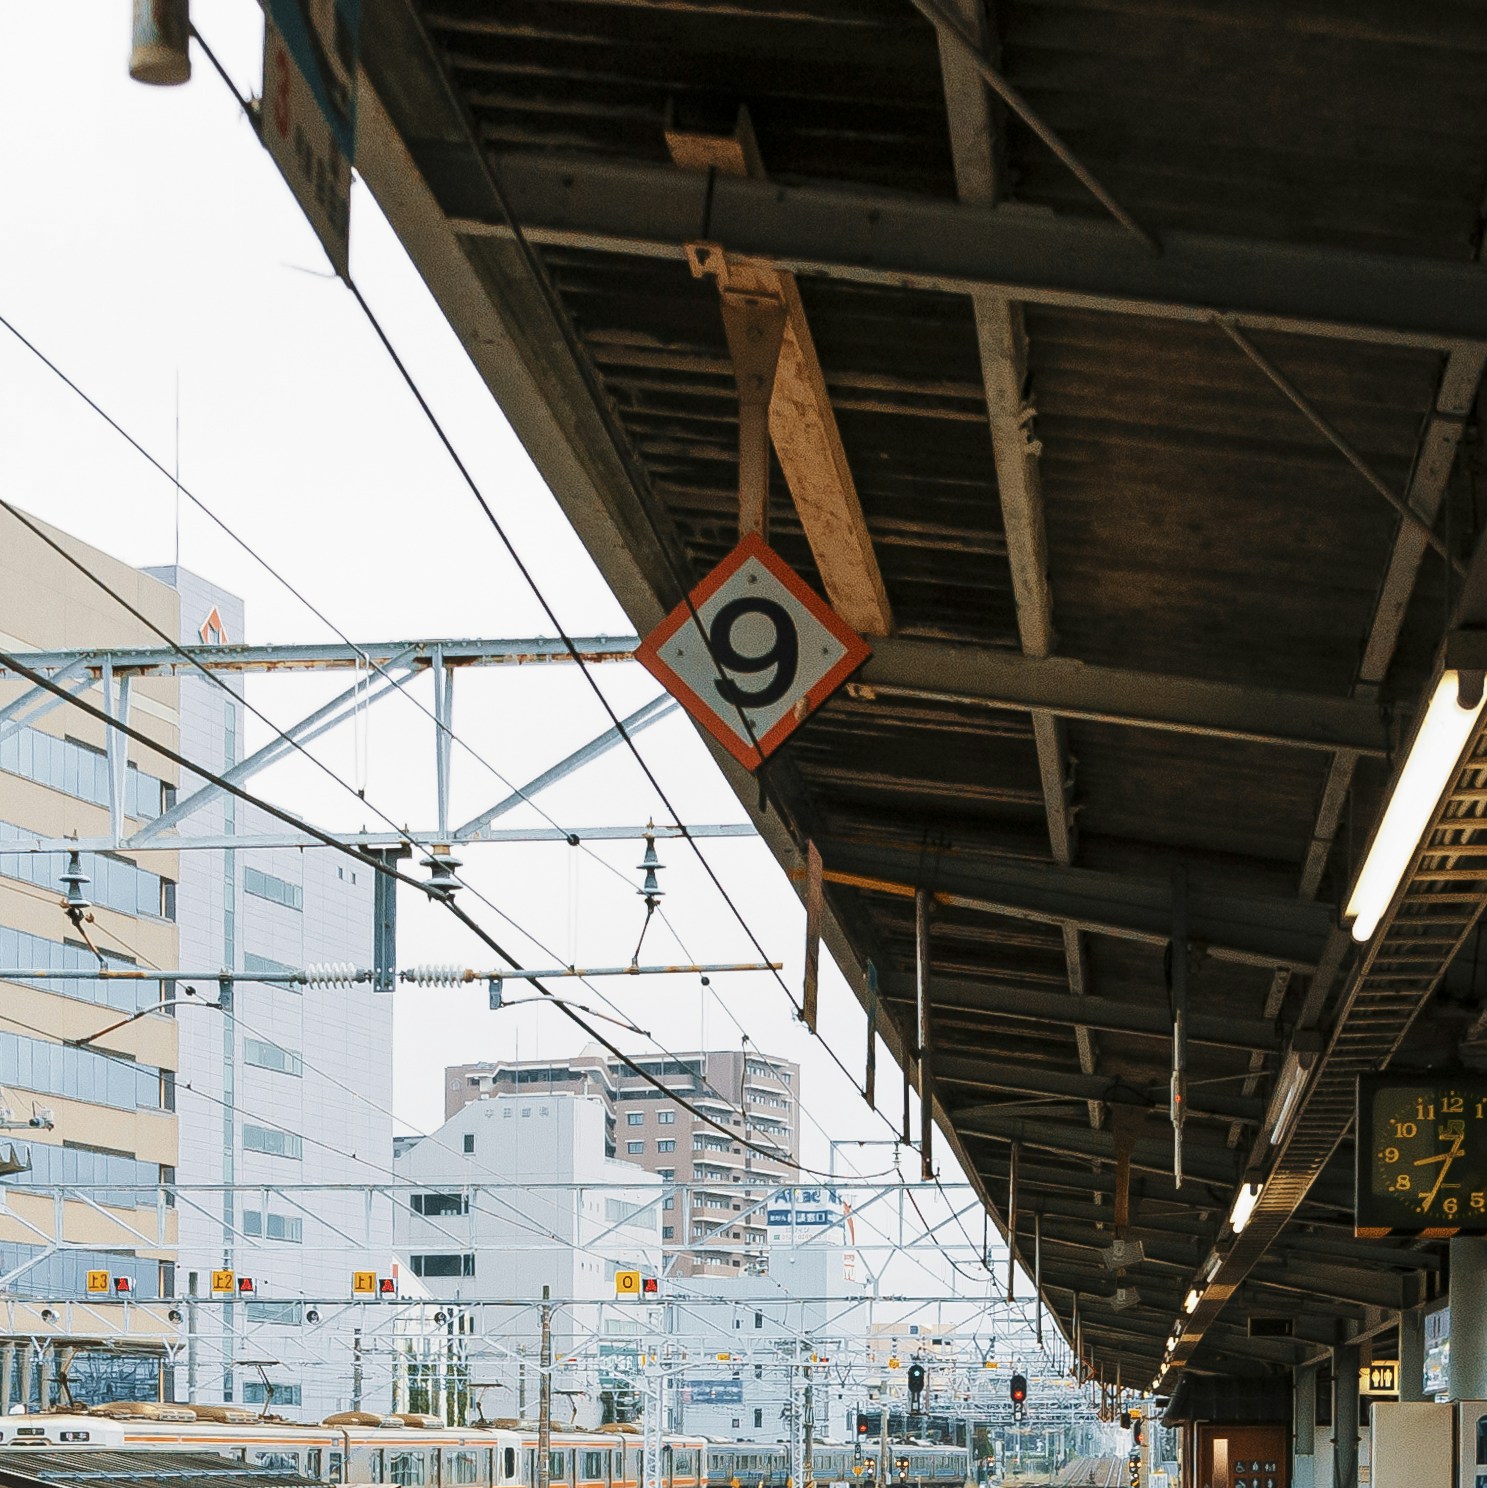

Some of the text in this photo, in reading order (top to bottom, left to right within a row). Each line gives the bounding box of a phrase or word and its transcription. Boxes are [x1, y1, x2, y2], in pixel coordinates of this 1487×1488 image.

[709, 597, 798, 709] 9
[1416, 1104, 1436, 1120] 11
[1441, 1097, 1464, 1113] 12
[1475, 1103, 1484, 1119] 1
[1395, 1122, 1417, 1138] 10
[1384, 1147, 1399, 1163] 9
[1396, 1175, 1411, 1190] 8
[1443, 1197, 1458, 1213] 6
[1470, 1192, 1485, 1208] 5
[89, 1273, 107, 1289] 上3
[213, 1273, 233, 1290] 上2
[354, 1273, 374, 1290] 上1
